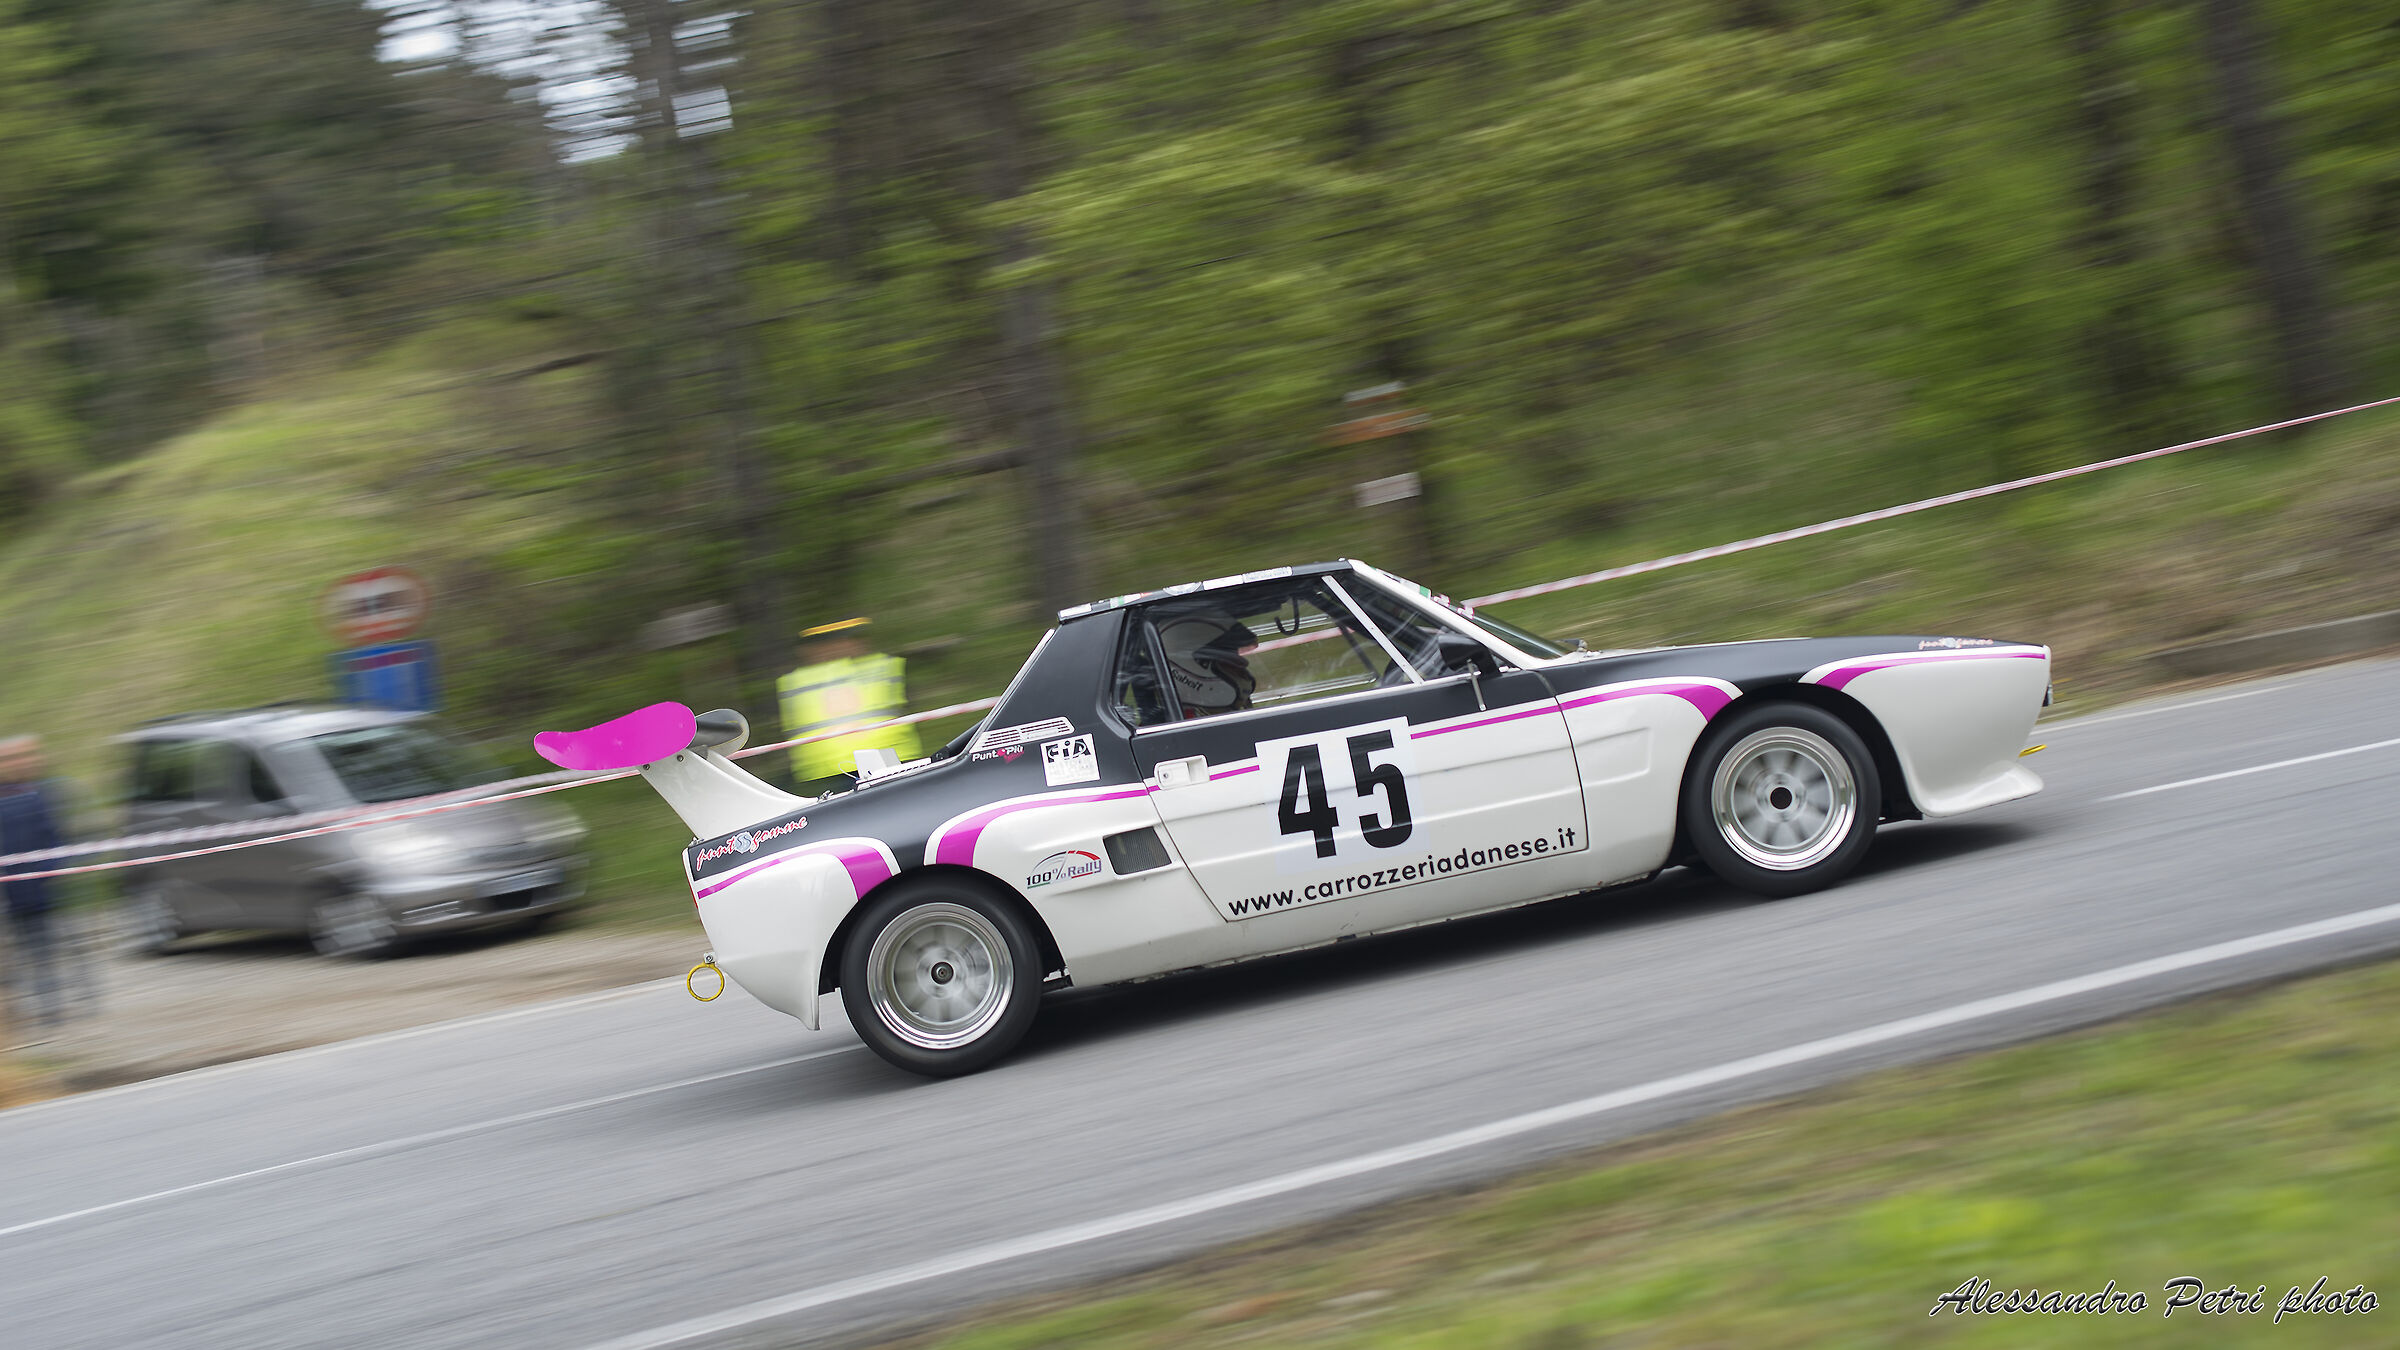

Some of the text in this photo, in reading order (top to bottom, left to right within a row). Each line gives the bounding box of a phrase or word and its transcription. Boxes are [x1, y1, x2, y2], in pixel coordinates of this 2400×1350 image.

[1278, 729, 1413, 860] 45
[1026, 860, 1102, 886] 100% Rally
[1228, 827, 1577, 916] www.carrozzeriadanese.it
